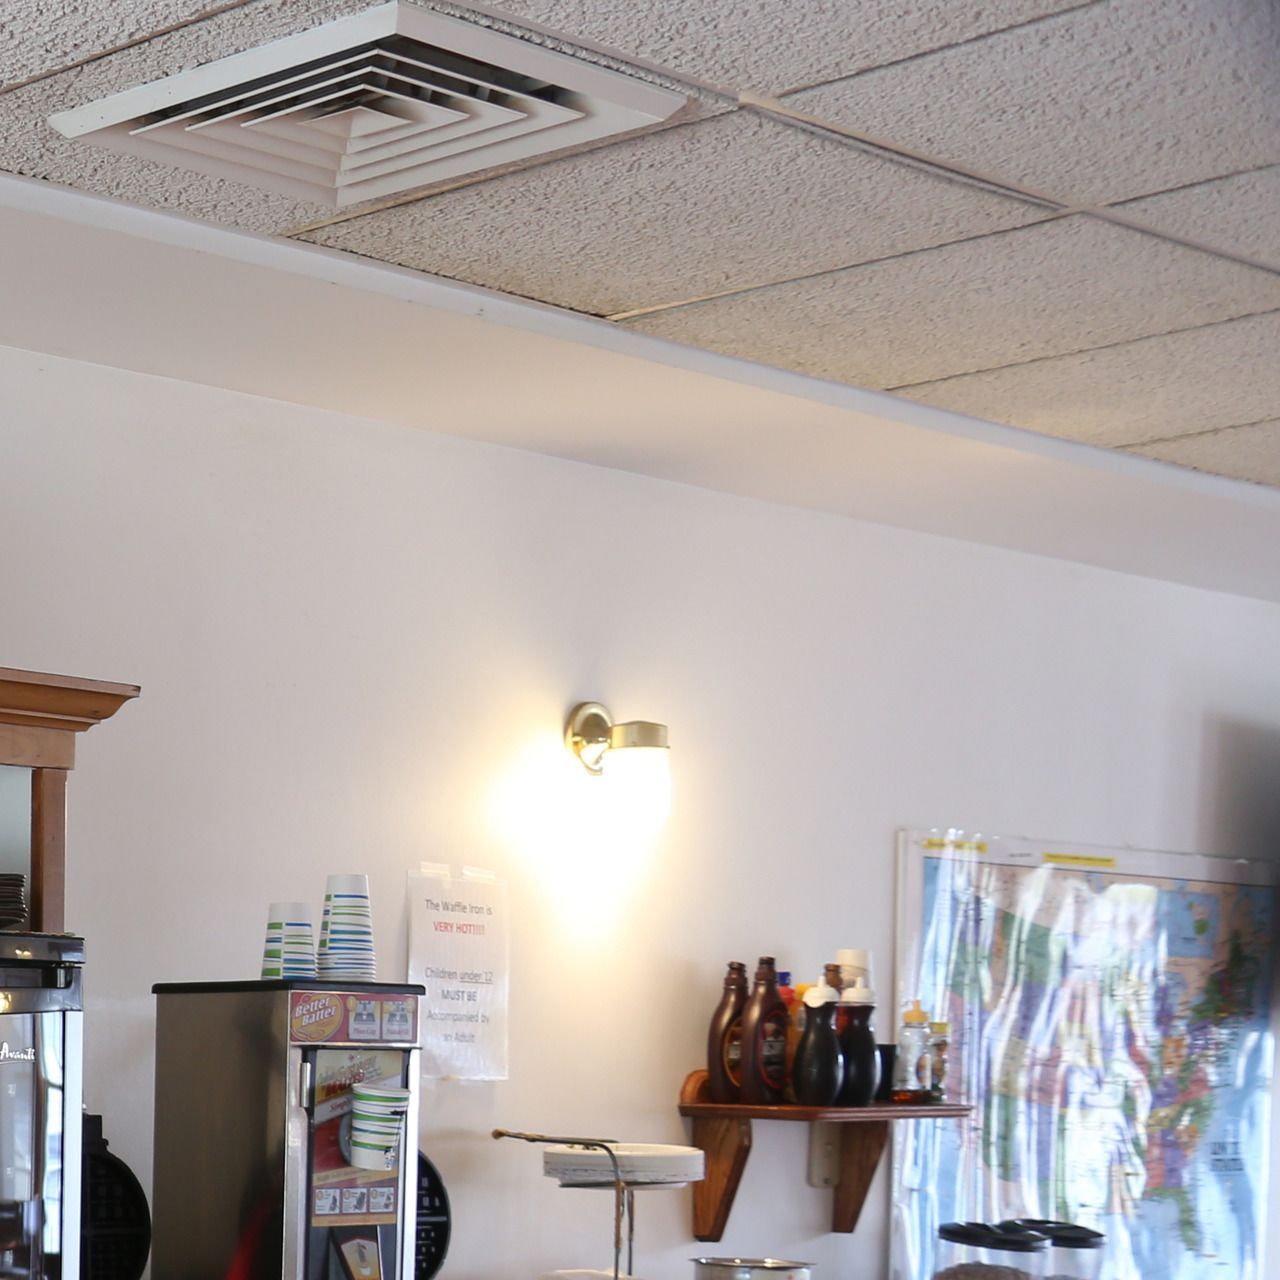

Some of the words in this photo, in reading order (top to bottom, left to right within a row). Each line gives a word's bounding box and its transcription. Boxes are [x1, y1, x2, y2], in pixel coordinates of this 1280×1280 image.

[425, 900, 439, 911] The
[441, 902, 467, 913] Waffle
[469, 904, 484, 914] Iron
[486, 906, 493, 915] is
[433, 921, 454, 933] VERY
[425, 966, 457, 979] Children
[460, 971, 482, 982] under
[441, 989, 464, 1001] MUST
[467, 991, 478, 1002] BE
[295, 997, 330, 1017] Better
[301, 1005, 337, 1026] Batter
[426, 1009, 478, 1024] Accompanied
[0, 1041, 35, 1060] Avanti
